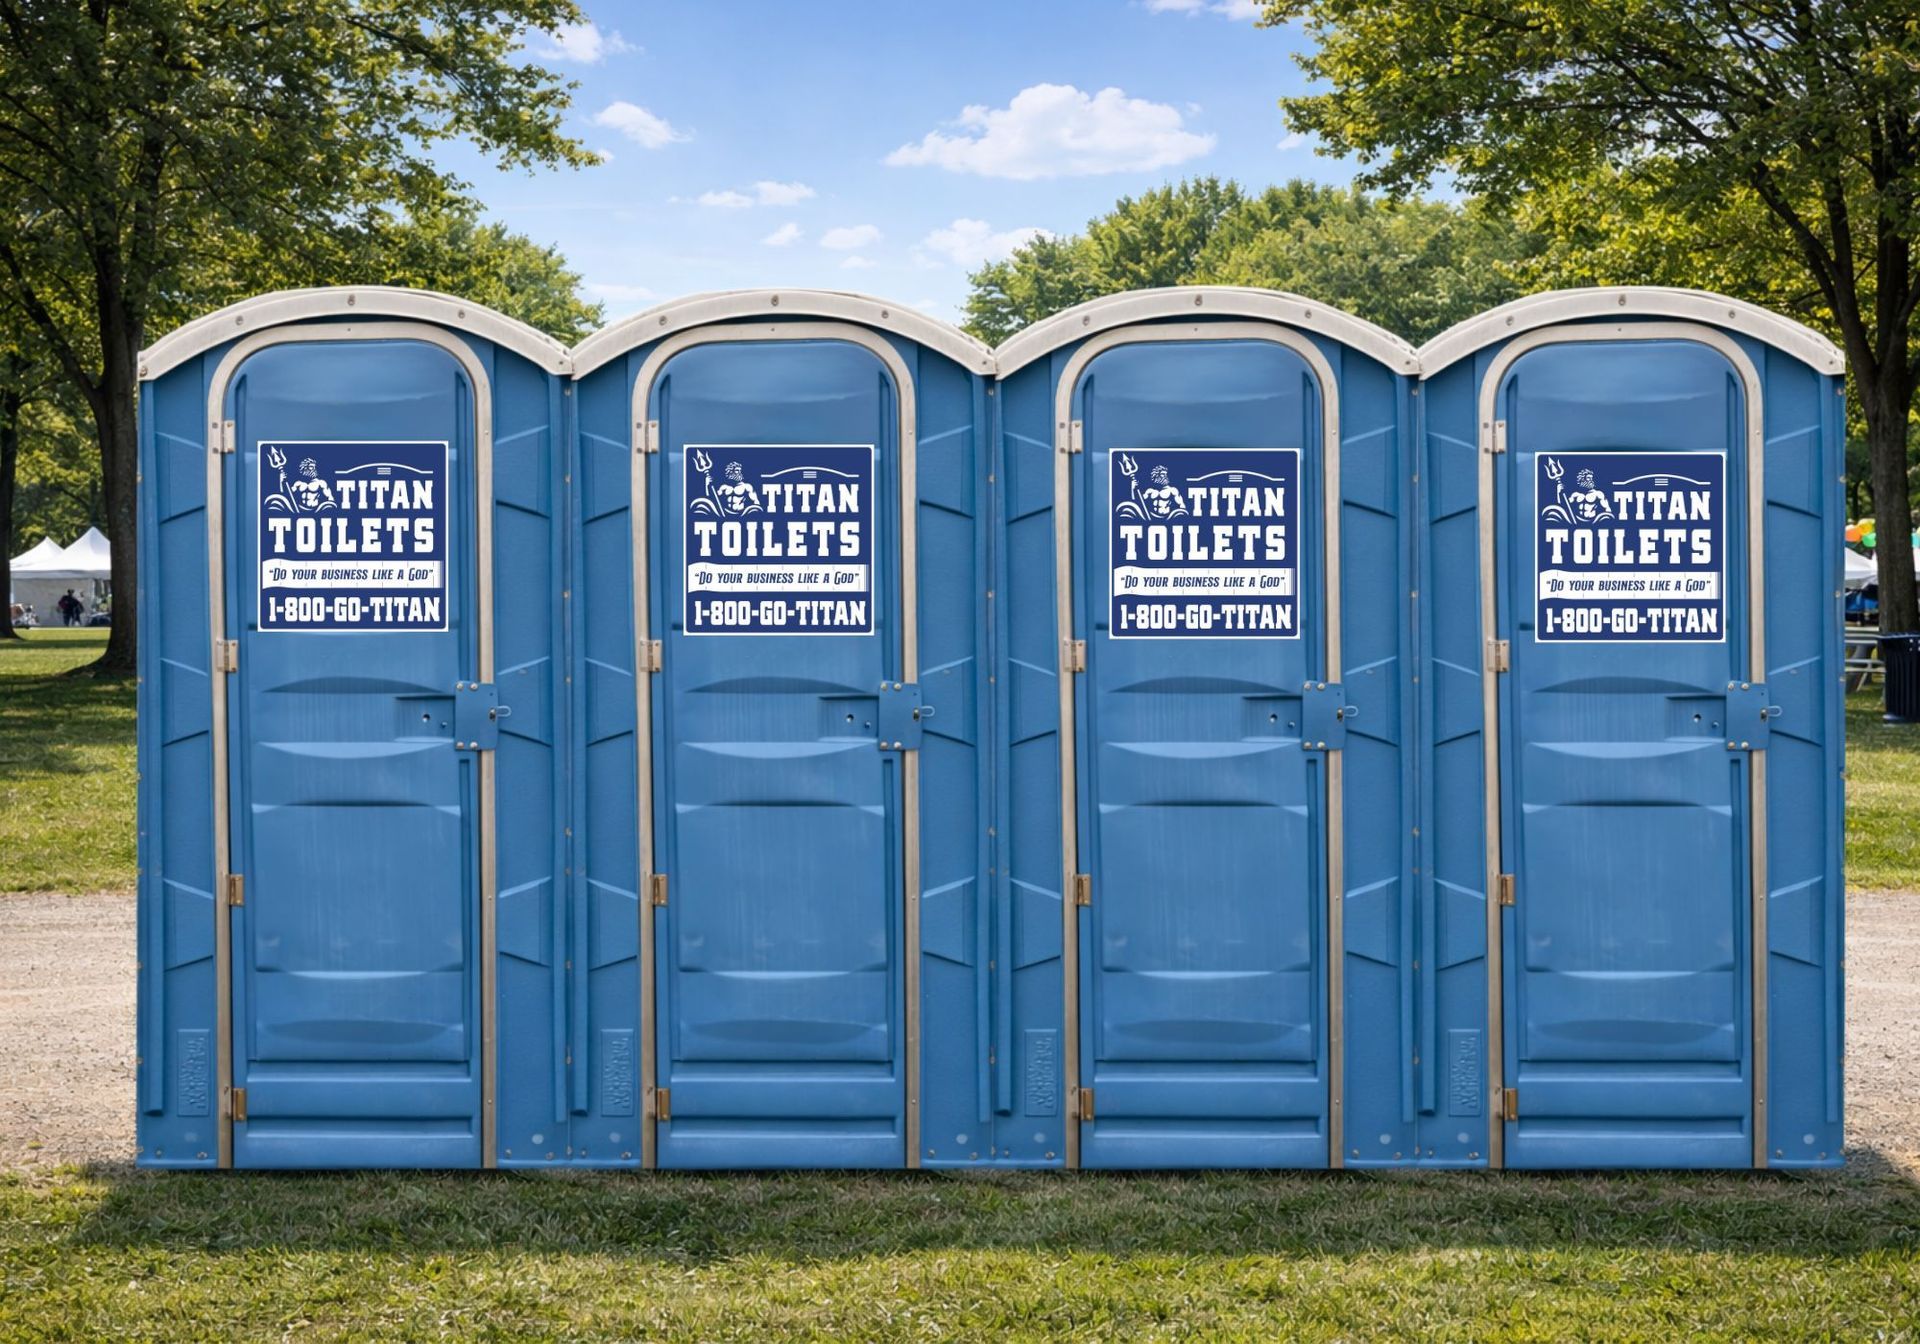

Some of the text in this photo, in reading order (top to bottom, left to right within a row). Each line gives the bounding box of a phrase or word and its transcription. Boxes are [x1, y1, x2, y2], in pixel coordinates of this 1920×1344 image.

[337, 480, 432, 509] TITAN
[764, 484, 858, 512] TITAN
[1189, 488, 1284, 516] TITAN
[1614, 492, 1710, 520] TITAN
[269, 518, 433, 552] TOILETS
[694, 522, 859, 556] TOILETS
[1120, 526, 1285, 560] TOILETS
[1546, 529, 1711, 563] TOILETS
[270, 597, 439, 621] 1-800-GO-TITAN
[695, 601, 865, 625] 1-800-GO-TITAN
[1121, 605, 1291, 629] 1-800-GO-TITAN
[1547, 608, 1717, 632] 1-800-GO-TITAN
